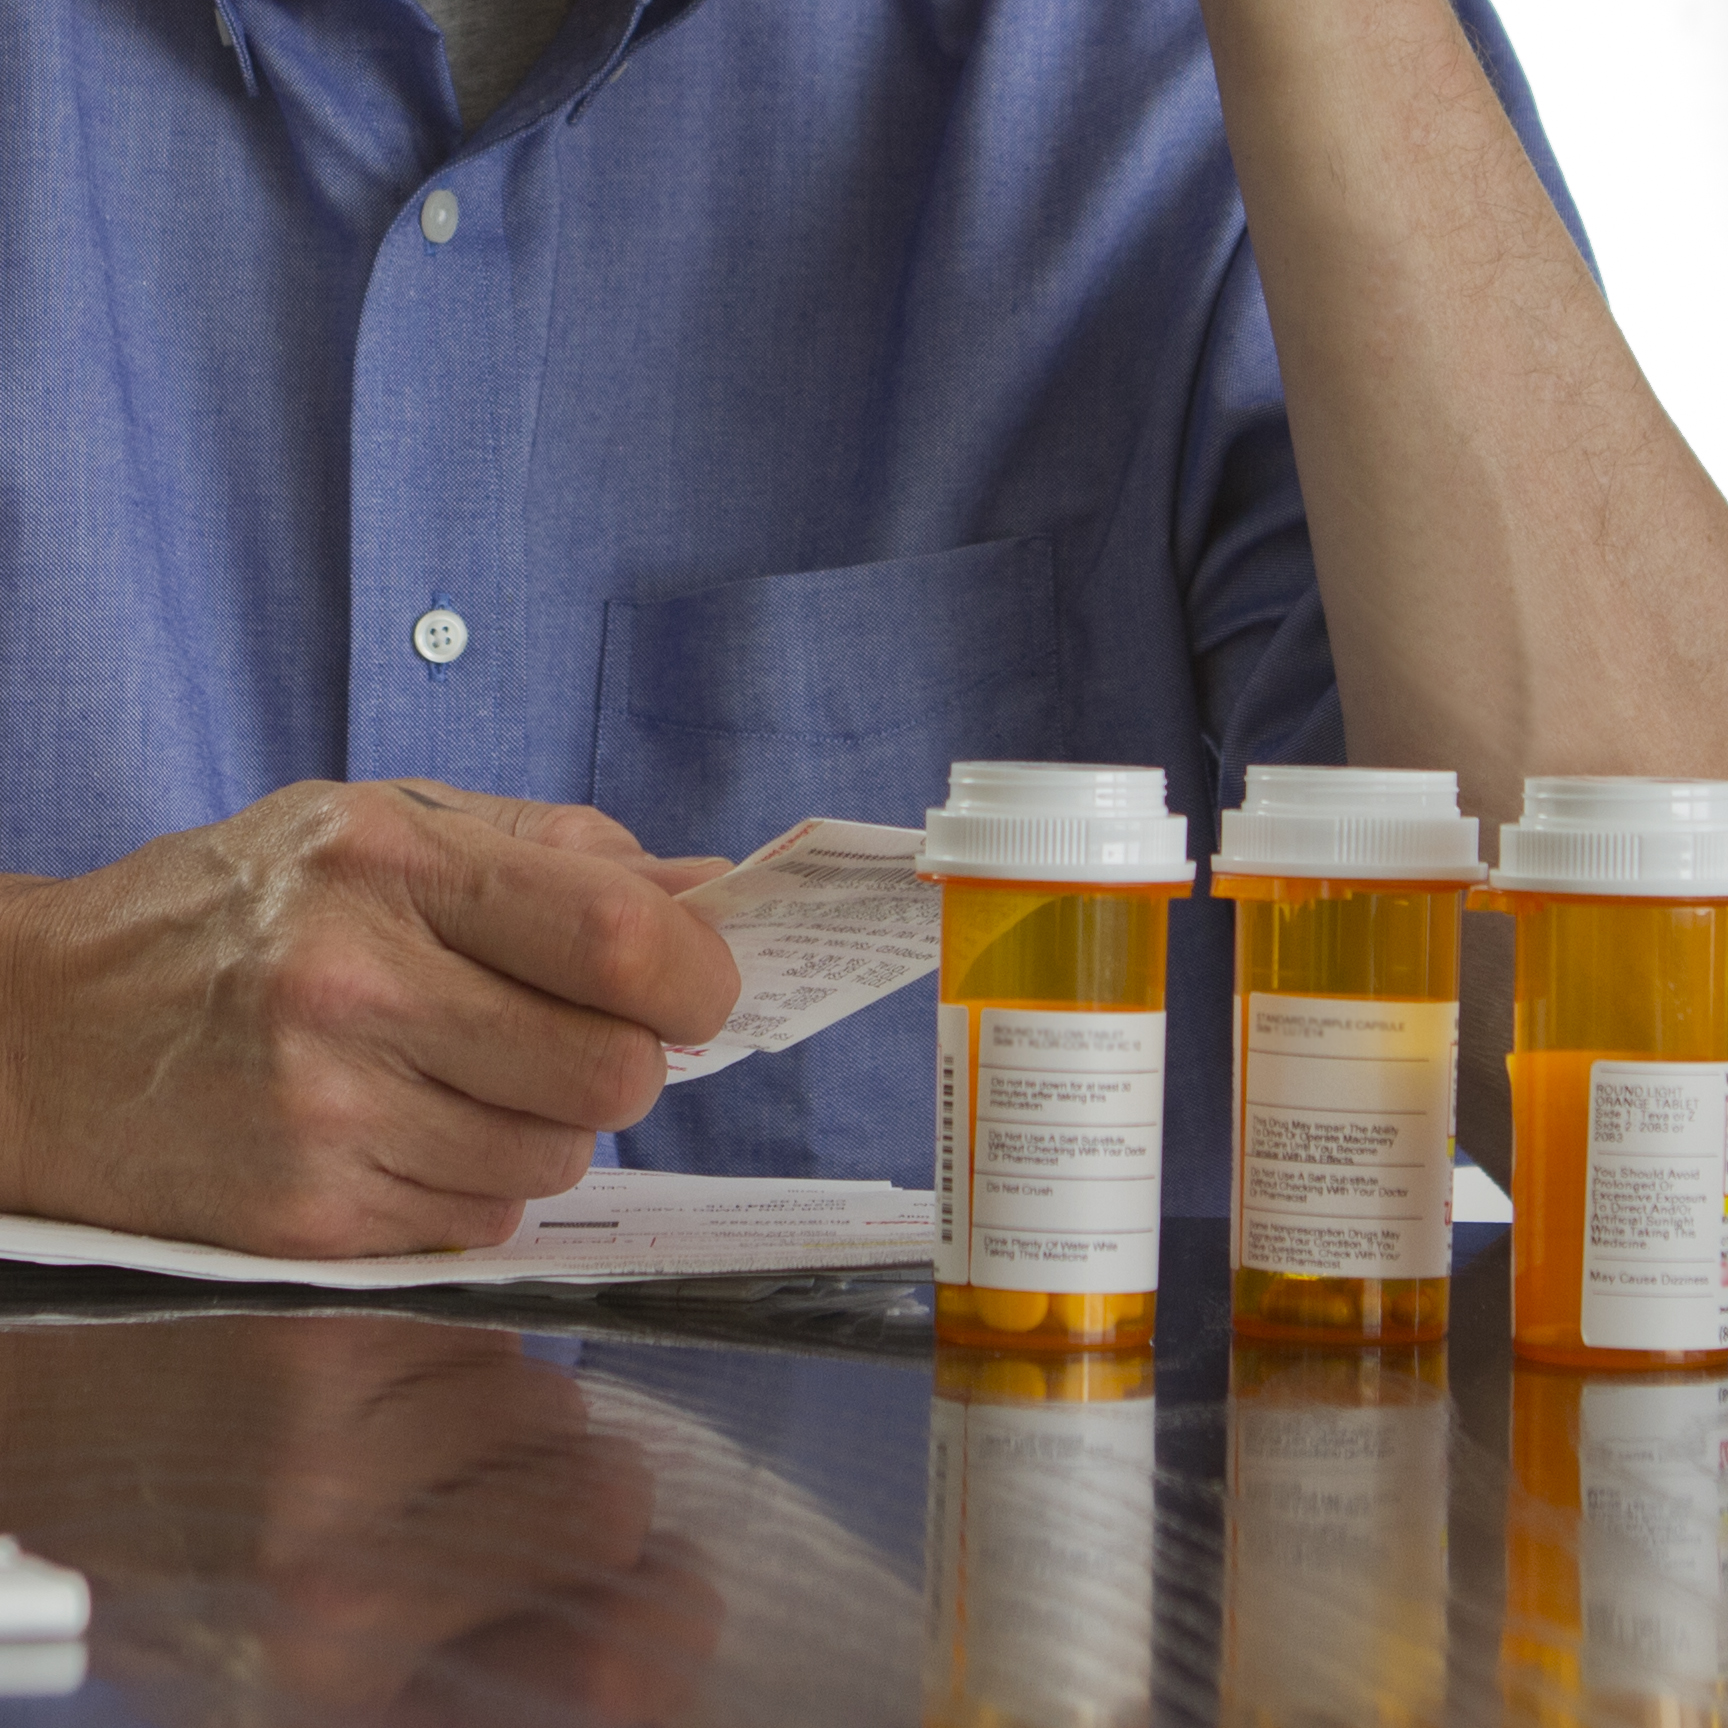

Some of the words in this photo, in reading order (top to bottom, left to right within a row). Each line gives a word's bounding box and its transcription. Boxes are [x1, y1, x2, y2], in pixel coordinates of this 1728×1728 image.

[875, 945, 936, 961] APPROVED
[863, 968, 898, 982] TOTAL
[875, 961, 910, 976] TOTAL
[850, 975, 887, 988] TOTAL
[1308, 1017, 1352, 1030] PURPLE
[1356, 1020, 1406, 1032] CAPSULE
[991, 1078, 1004, 1087] Do
[1007, 1080, 1022, 1088] not
[1070, 1082, 1082, 1091] for
[1596, 1084, 1643, 1098] ROUND
[1647, 1086, 1683, 1098] LIGHT
[1031, 1092, 1053, 1100] after
[1057, 1093, 1087, 1104] taking
[1090, 1094, 1106, 1103] this
[1595, 1096, 1650, 1109] ORANGE
[1656, 1099, 1699, 1110] TABLET
[1595, 1108, 1621, 1119] Side
[1641, 1110, 1669, 1122] Teva
[1673, 1113, 1685, 1122] or
[1269, 1117, 1289, 1130] Drug
[1292, 1120, 1311, 1132] May
[1315, 1122, 1345, 1135] Impair
[1350, 1124, 1368, 1135] The
[1371, 1125, 1399, 1137] Ability
[1595, 1119, 1621, 1132] Side
[1639, 1122, 1669, 1133] 2083
[1672, 1123, 1685, 1134] or
[988, 1131, 1002, 1142] Do
[1005, 1132, 1022, 1142] Not
[1024, 1133, 1045, 1143] Use
[1047, 1135, 1056, 1144] A
[1059, 1135, 1078, 1145] Salt
[1263, 1128, 1283, 1139] Drive
[1286, 1130, 1295, 1140] Or
[1300, 1131, 1340, 1144] Operate
[1594, 1131, 1623, 1143] 2083
[988, 1142, 1024, 1153] Without
[1027, 1145, 1075, 1158] Checking
[1078, 1147, 1100, 1156] With
[1103, 1147, 1122, 1157] Your
[1267, 1138, 1287, 1148] Care
[1290, 1141, 1311, 1151] Until
[1315, 1143, 1334, 1154] You
[1337, 1145, 1378, 1156] Become
[988, 1152, 998, 1162] Or
[1002, 1154, 1059, 1166] Pharmacist
[1282, 1151, 1303, 1162] With
[1250, 1167, 1260, 1176] Do
[1262, 1168, 1276, 1178] Not
[1277, 1170, 1295, 1181] Use
[1297, 1172, 1305, 1181] A
[1308, 1173, 1327, 1183] Salt
[1330, 1175, 1379, 1186] Substitute
[1593, 1165, 1616, 1179] You
[1620, 1166, 1664, 1180] Should
[1668, 1168, 1700, 1181] Avoid
[986, 1182, 1000, 1193] Do
[1002, 1184, 1020, 1194] Not
[1022, 1186, 1053, 1197] Crush
[1250, 1178, 1277, 1189] Without
[1279, 1181, 1323, 1195] Checking
[1327, 1185, 1349, 1195] With
[1351, 1186, 1375, 1196] Your
[1378, 1187, 1409, 1198] Doctor
[1593, 1178, 1656, 1193] Prolonged
[1660, 1181, 1675, 1192] Or
[1250, 1188, 1257, 1198] Or
[1259, 1190, 1307, 1204] Pharmacist
[1592, 1189, 1652, 1203] Excessive
[1656, 1192, 1708, 1206] Exposure
[1593, 1202, 1607, 1213] To
[1611, 1203, 1647, 1214] Direct
[1651, 1204, 1692, 1216] And/Or
[1591, 1213, 1642, 1226] Artificial
[1646, 1216, 1695, 1230] Sunlight
[1270, 1223, 1345, 1241] Nonprescription
[1349, 1229, 1378, 1243] Drugs
[1382, 1230, 1401, 1243] May
[1591, 1224, 1625, 1237] While
[1631, 1226, 1670, 1241] Taking
[1675, 1228, 1696, 1239] This
[984, 1236, 1008, 1247] Drink
[1012, 1238, 1042, 1251] Plenty
[1046, 1240, 1059, 1251] Of
[1060, 1241, 1090, 1251] Water
[1092, 1242, 1118, 1252] While
[1288, 1235, 1310, 1246] Your
[1376, 1241, 1394, 1251] You
[984, 1247, 1015, 1260] Taking
[1019, 1250, 1040, 1261] This
[1272, 1254, 1283, 1263] Or
[1318, 1248, 1351, 1259] Check
[1355, 1250, 1377, 1260] With
[1379, 1252, 1401, 1261] Your
[1590, 1269, 1616, 1285] May
[1620, 1272, 1657, 1285] Cause
[1661, 1273, 1709, 1286] Dizziness
